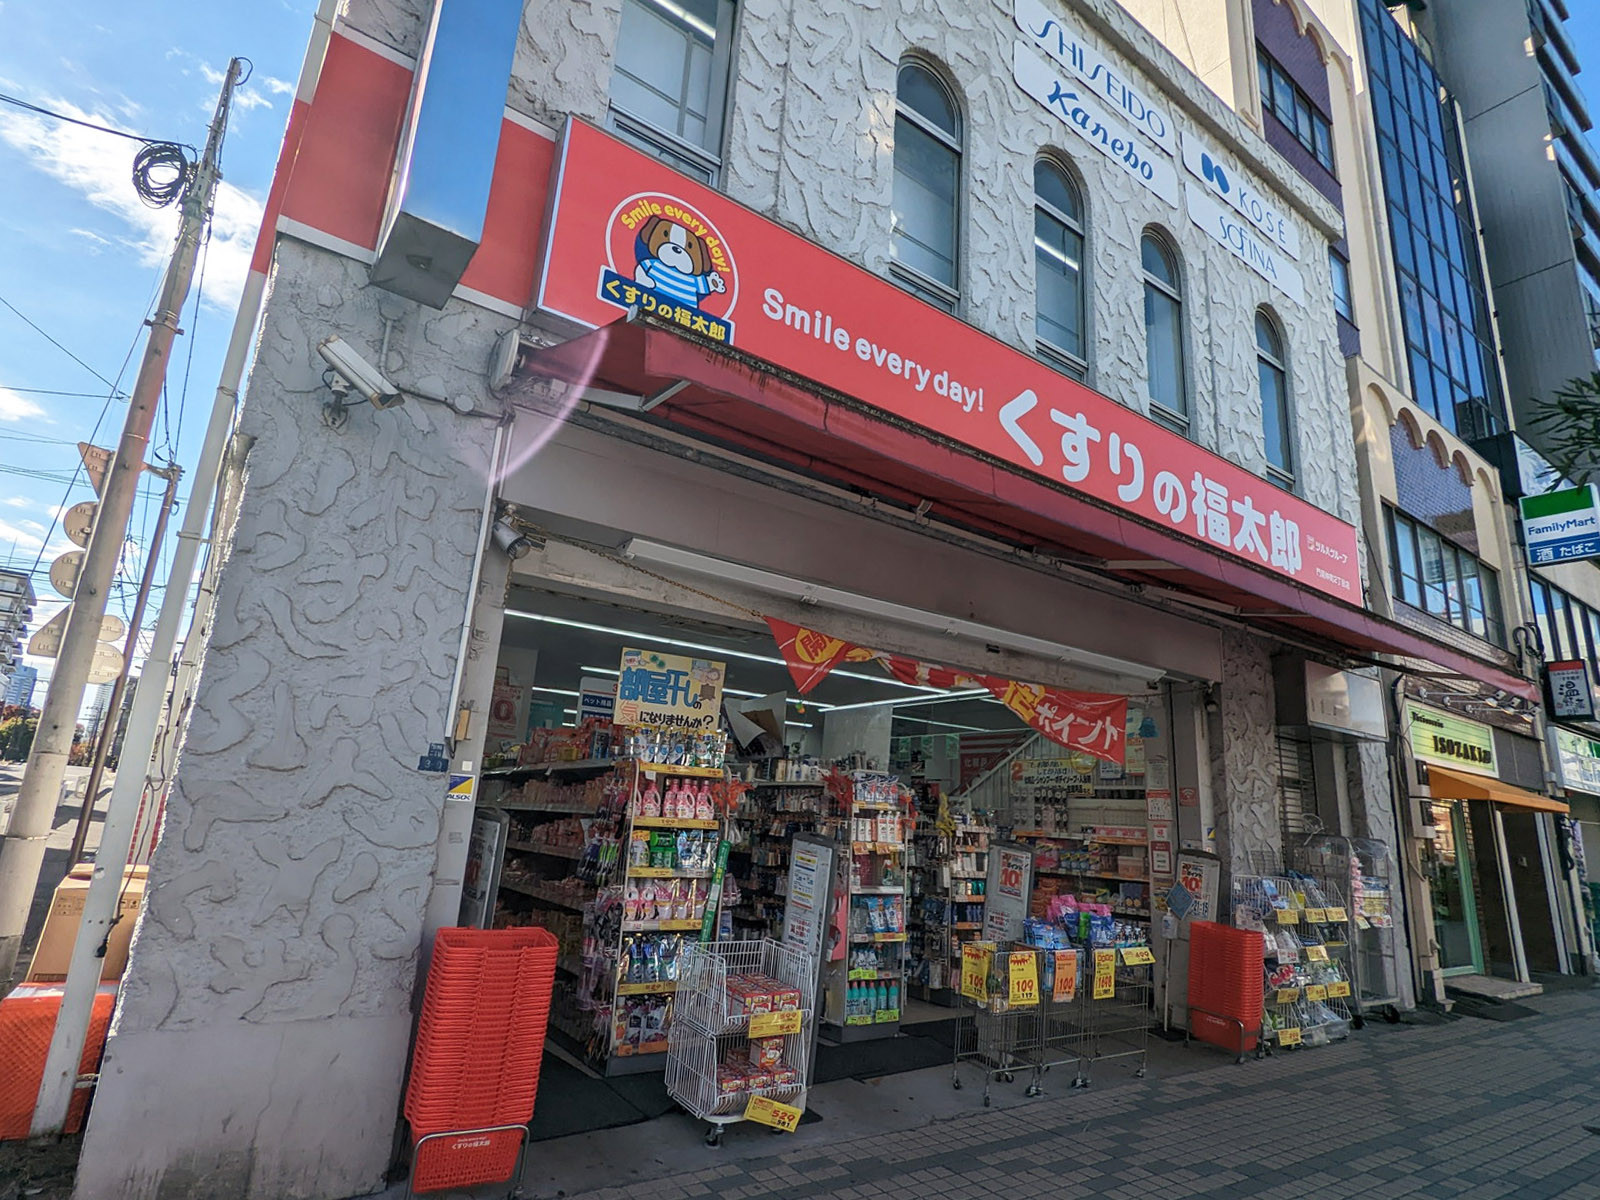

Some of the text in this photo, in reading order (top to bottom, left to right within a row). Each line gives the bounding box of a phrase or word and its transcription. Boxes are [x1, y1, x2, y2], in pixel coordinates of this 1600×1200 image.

[1028, 20, 1166, 138] SHISEIDO
[1047, 80, 1154, 181] Kanebo
[620, 199, 731, 273] Smile every day!
[1219, 216, 1278, 280] SOFINA
[605, 279, 727, 341] くすりの福太郎
[762, 288, 984, 412] Smile every day!
[999, 389, 1302, 575] くすりの福太郎
[1527, 516, 1596, 536] FamilyMart
[1536, 542, 1597, 562] 酒 たばこ
[446, 793, 470, 801] ALSOK
[1016, 979, 1034, 993] 109
[771, 1109, 796, 1122] 529
